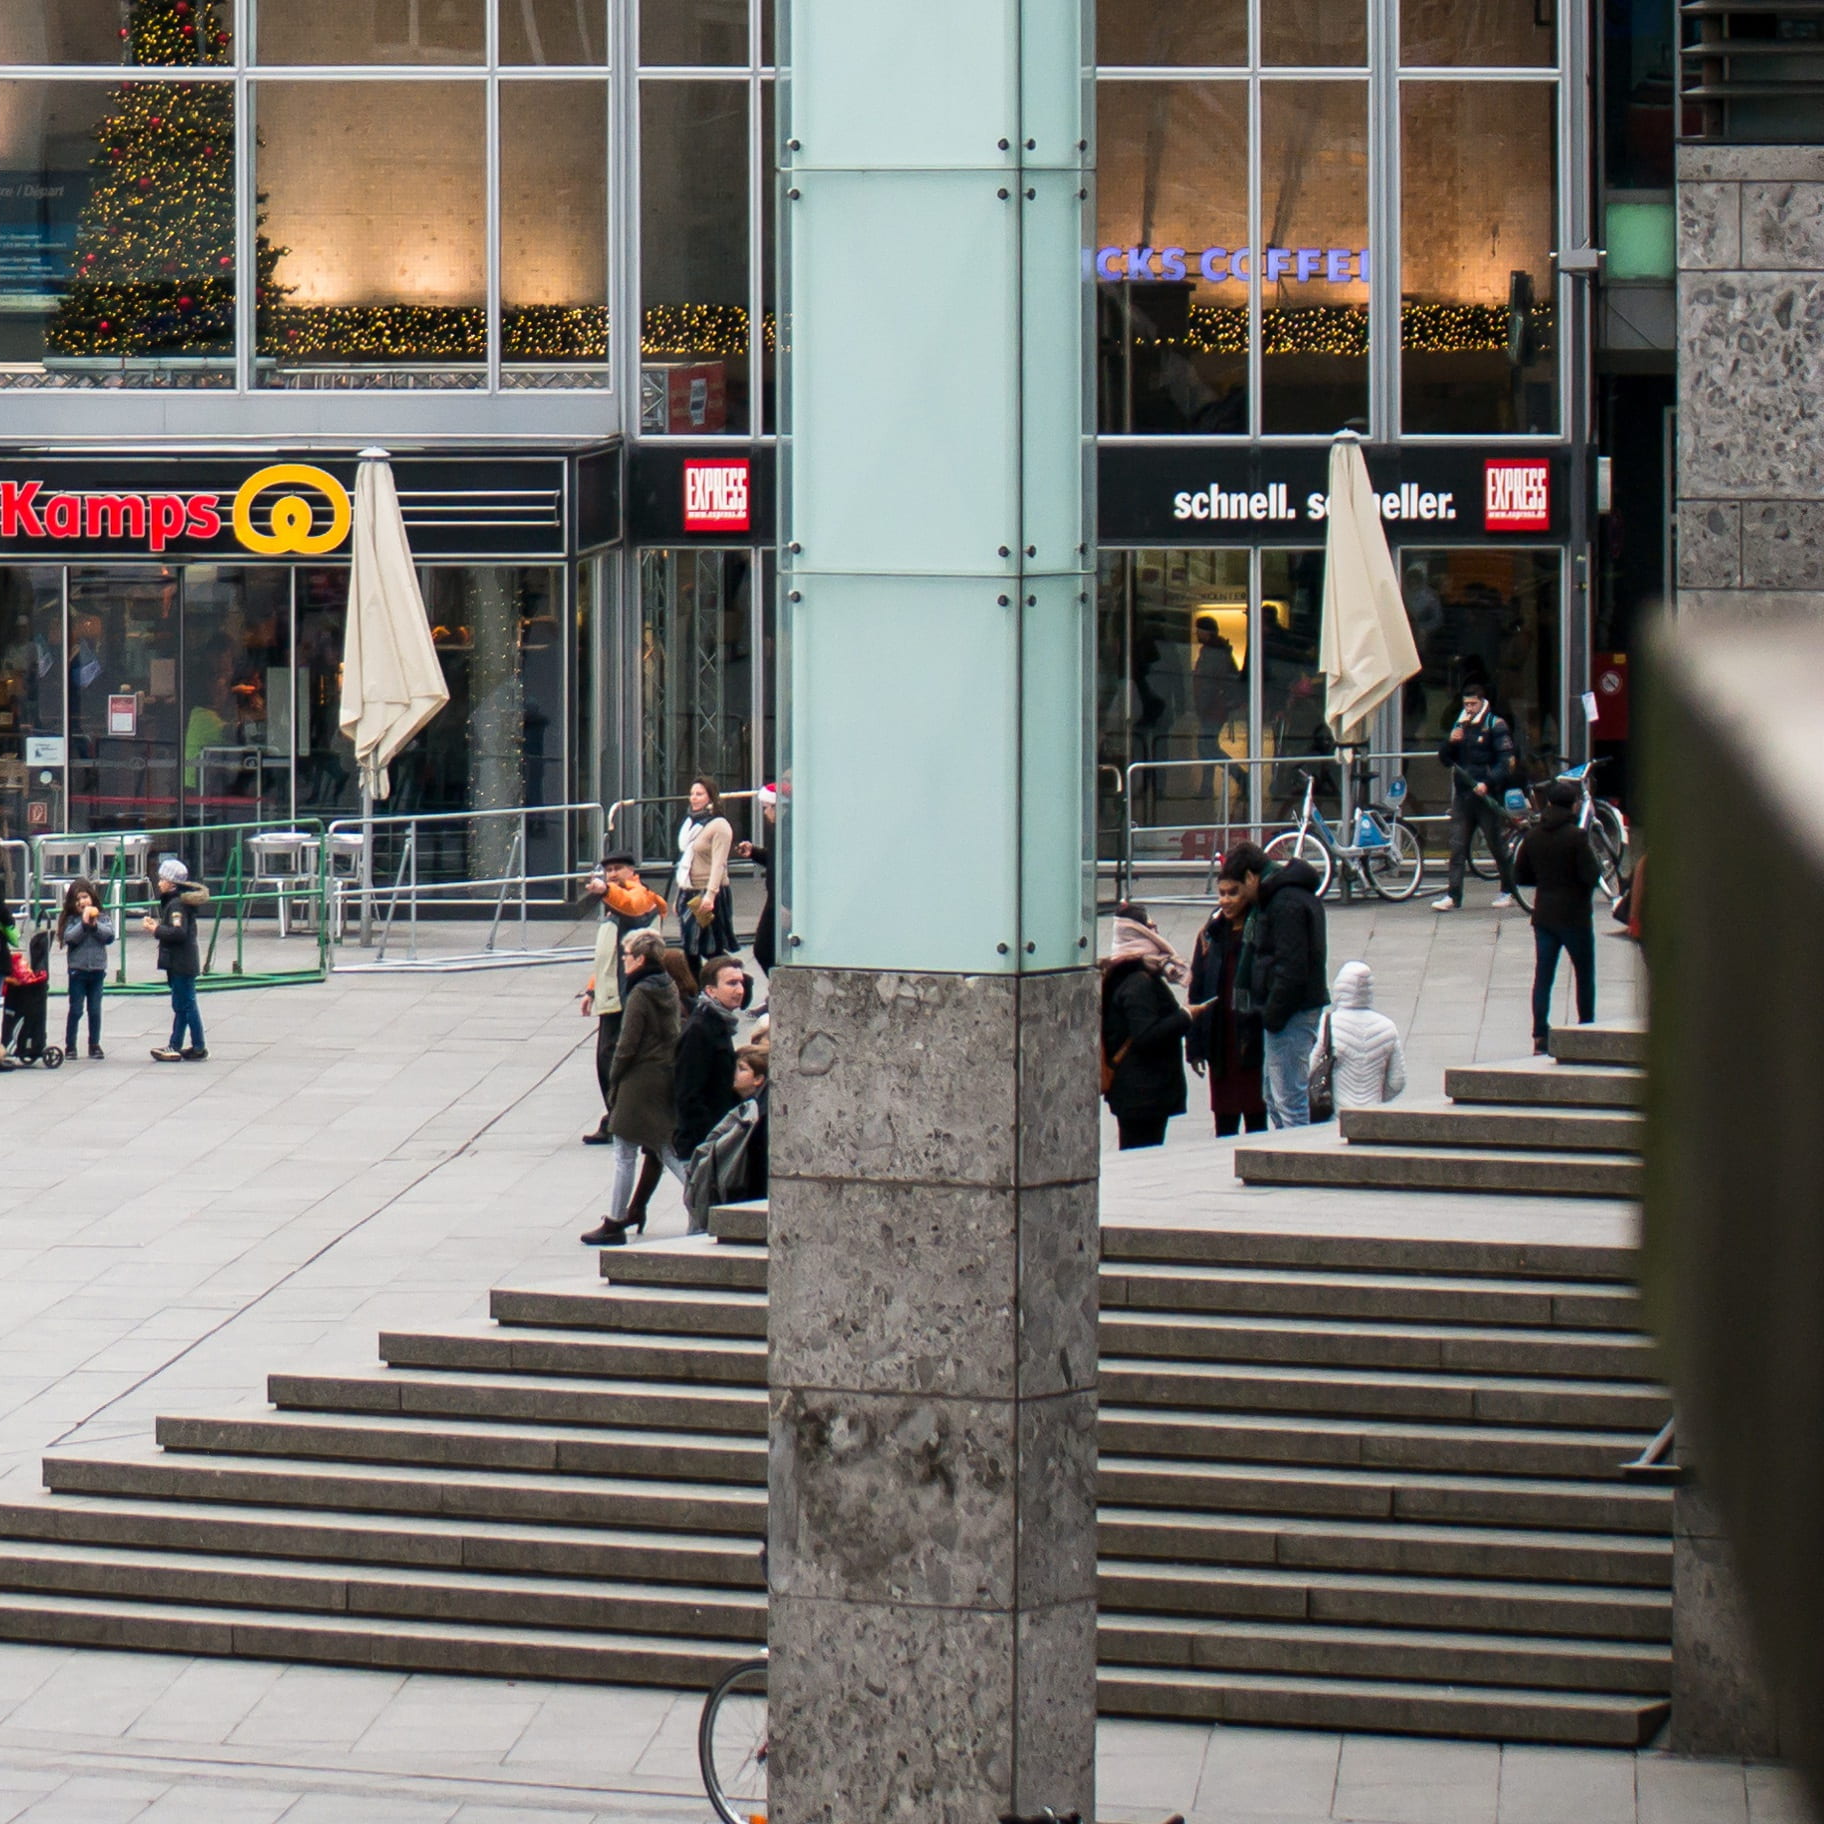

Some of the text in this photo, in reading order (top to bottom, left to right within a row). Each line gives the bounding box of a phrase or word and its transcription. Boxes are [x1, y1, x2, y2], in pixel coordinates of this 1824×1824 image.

[1081, 245, 1187, 283] CKS
[685, 467, 747, 511] EXPRESS
[1173, 482, 1456, 520] schnell. seller.
[1486, 467, 1547, 511] EXPRESS
